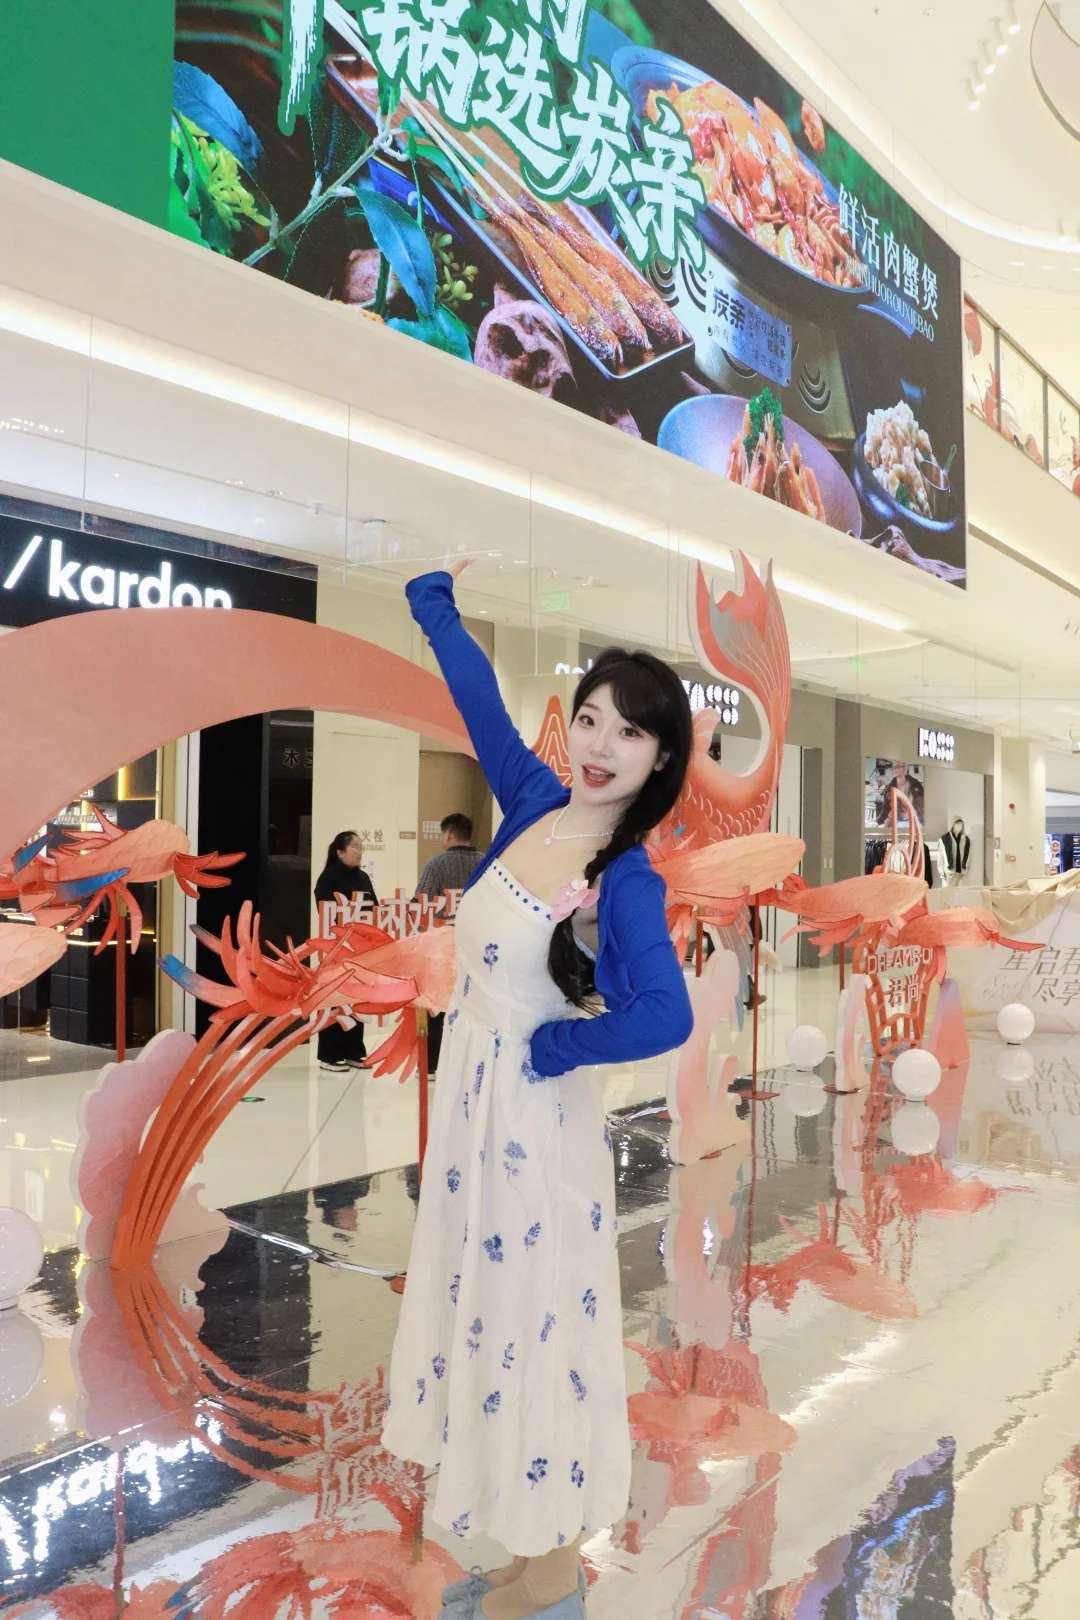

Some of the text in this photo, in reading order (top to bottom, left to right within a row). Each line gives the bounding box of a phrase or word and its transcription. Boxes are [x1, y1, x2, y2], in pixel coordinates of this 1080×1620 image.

[838, 182, 939, 321] 鲜活肉蟹煲
